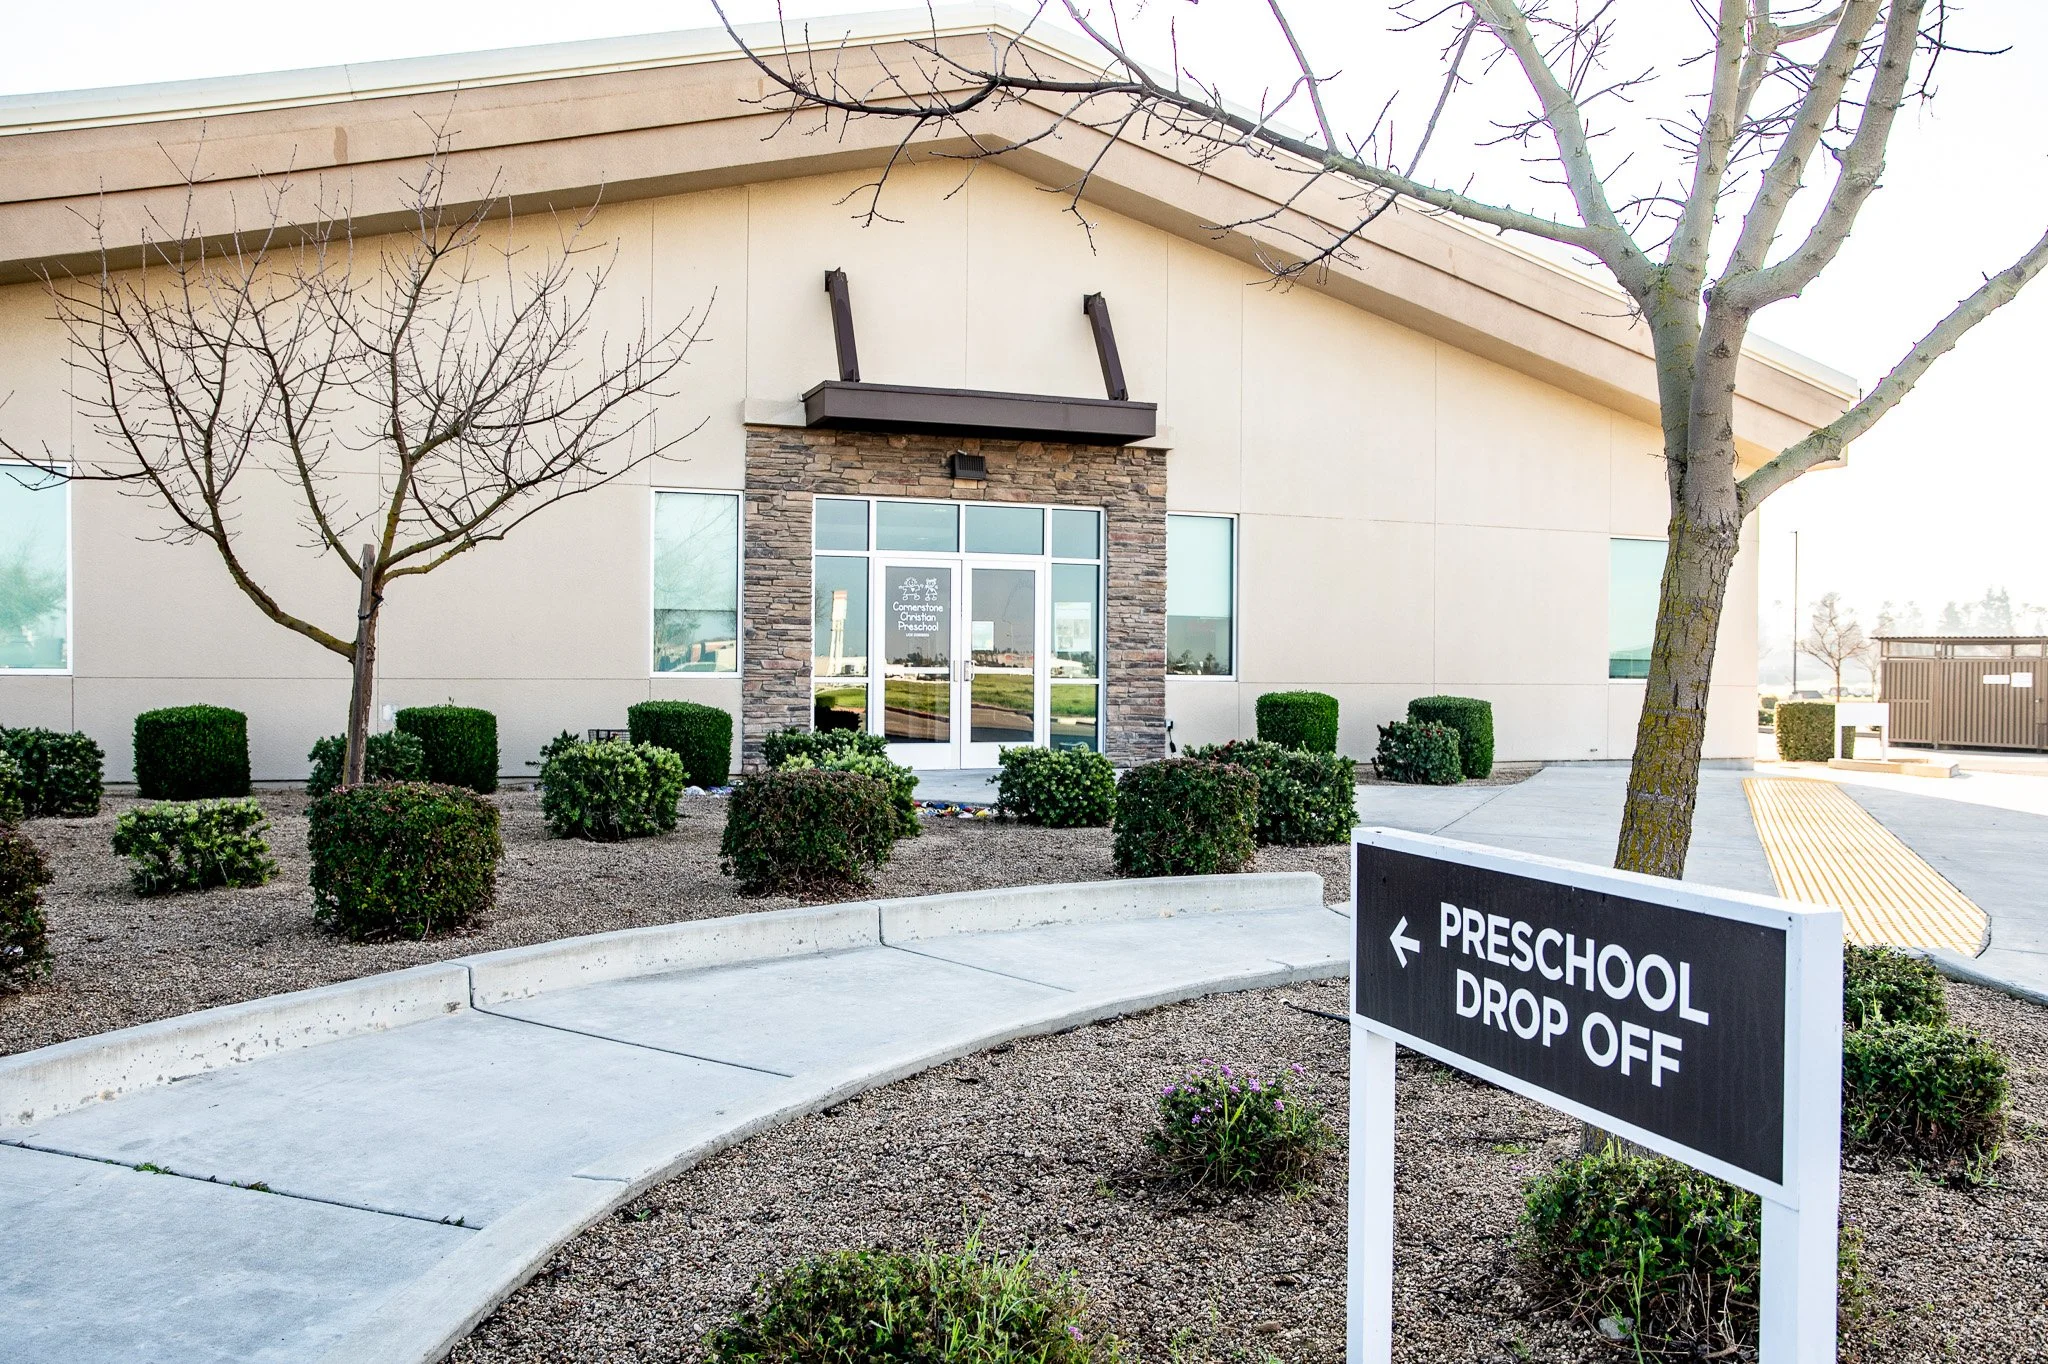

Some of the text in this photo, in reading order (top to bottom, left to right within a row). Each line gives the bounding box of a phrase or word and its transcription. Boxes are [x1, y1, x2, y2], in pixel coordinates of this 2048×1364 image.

[893, 601, 943, 612] Cornerstone
[900, 612, 936, 621] Christian
[898, 621, 938, 631] Preschool
[1440, 901, 1709, 1026] PRESCHOOL
[1456, 968, 1682, 1088] DROP OFF
